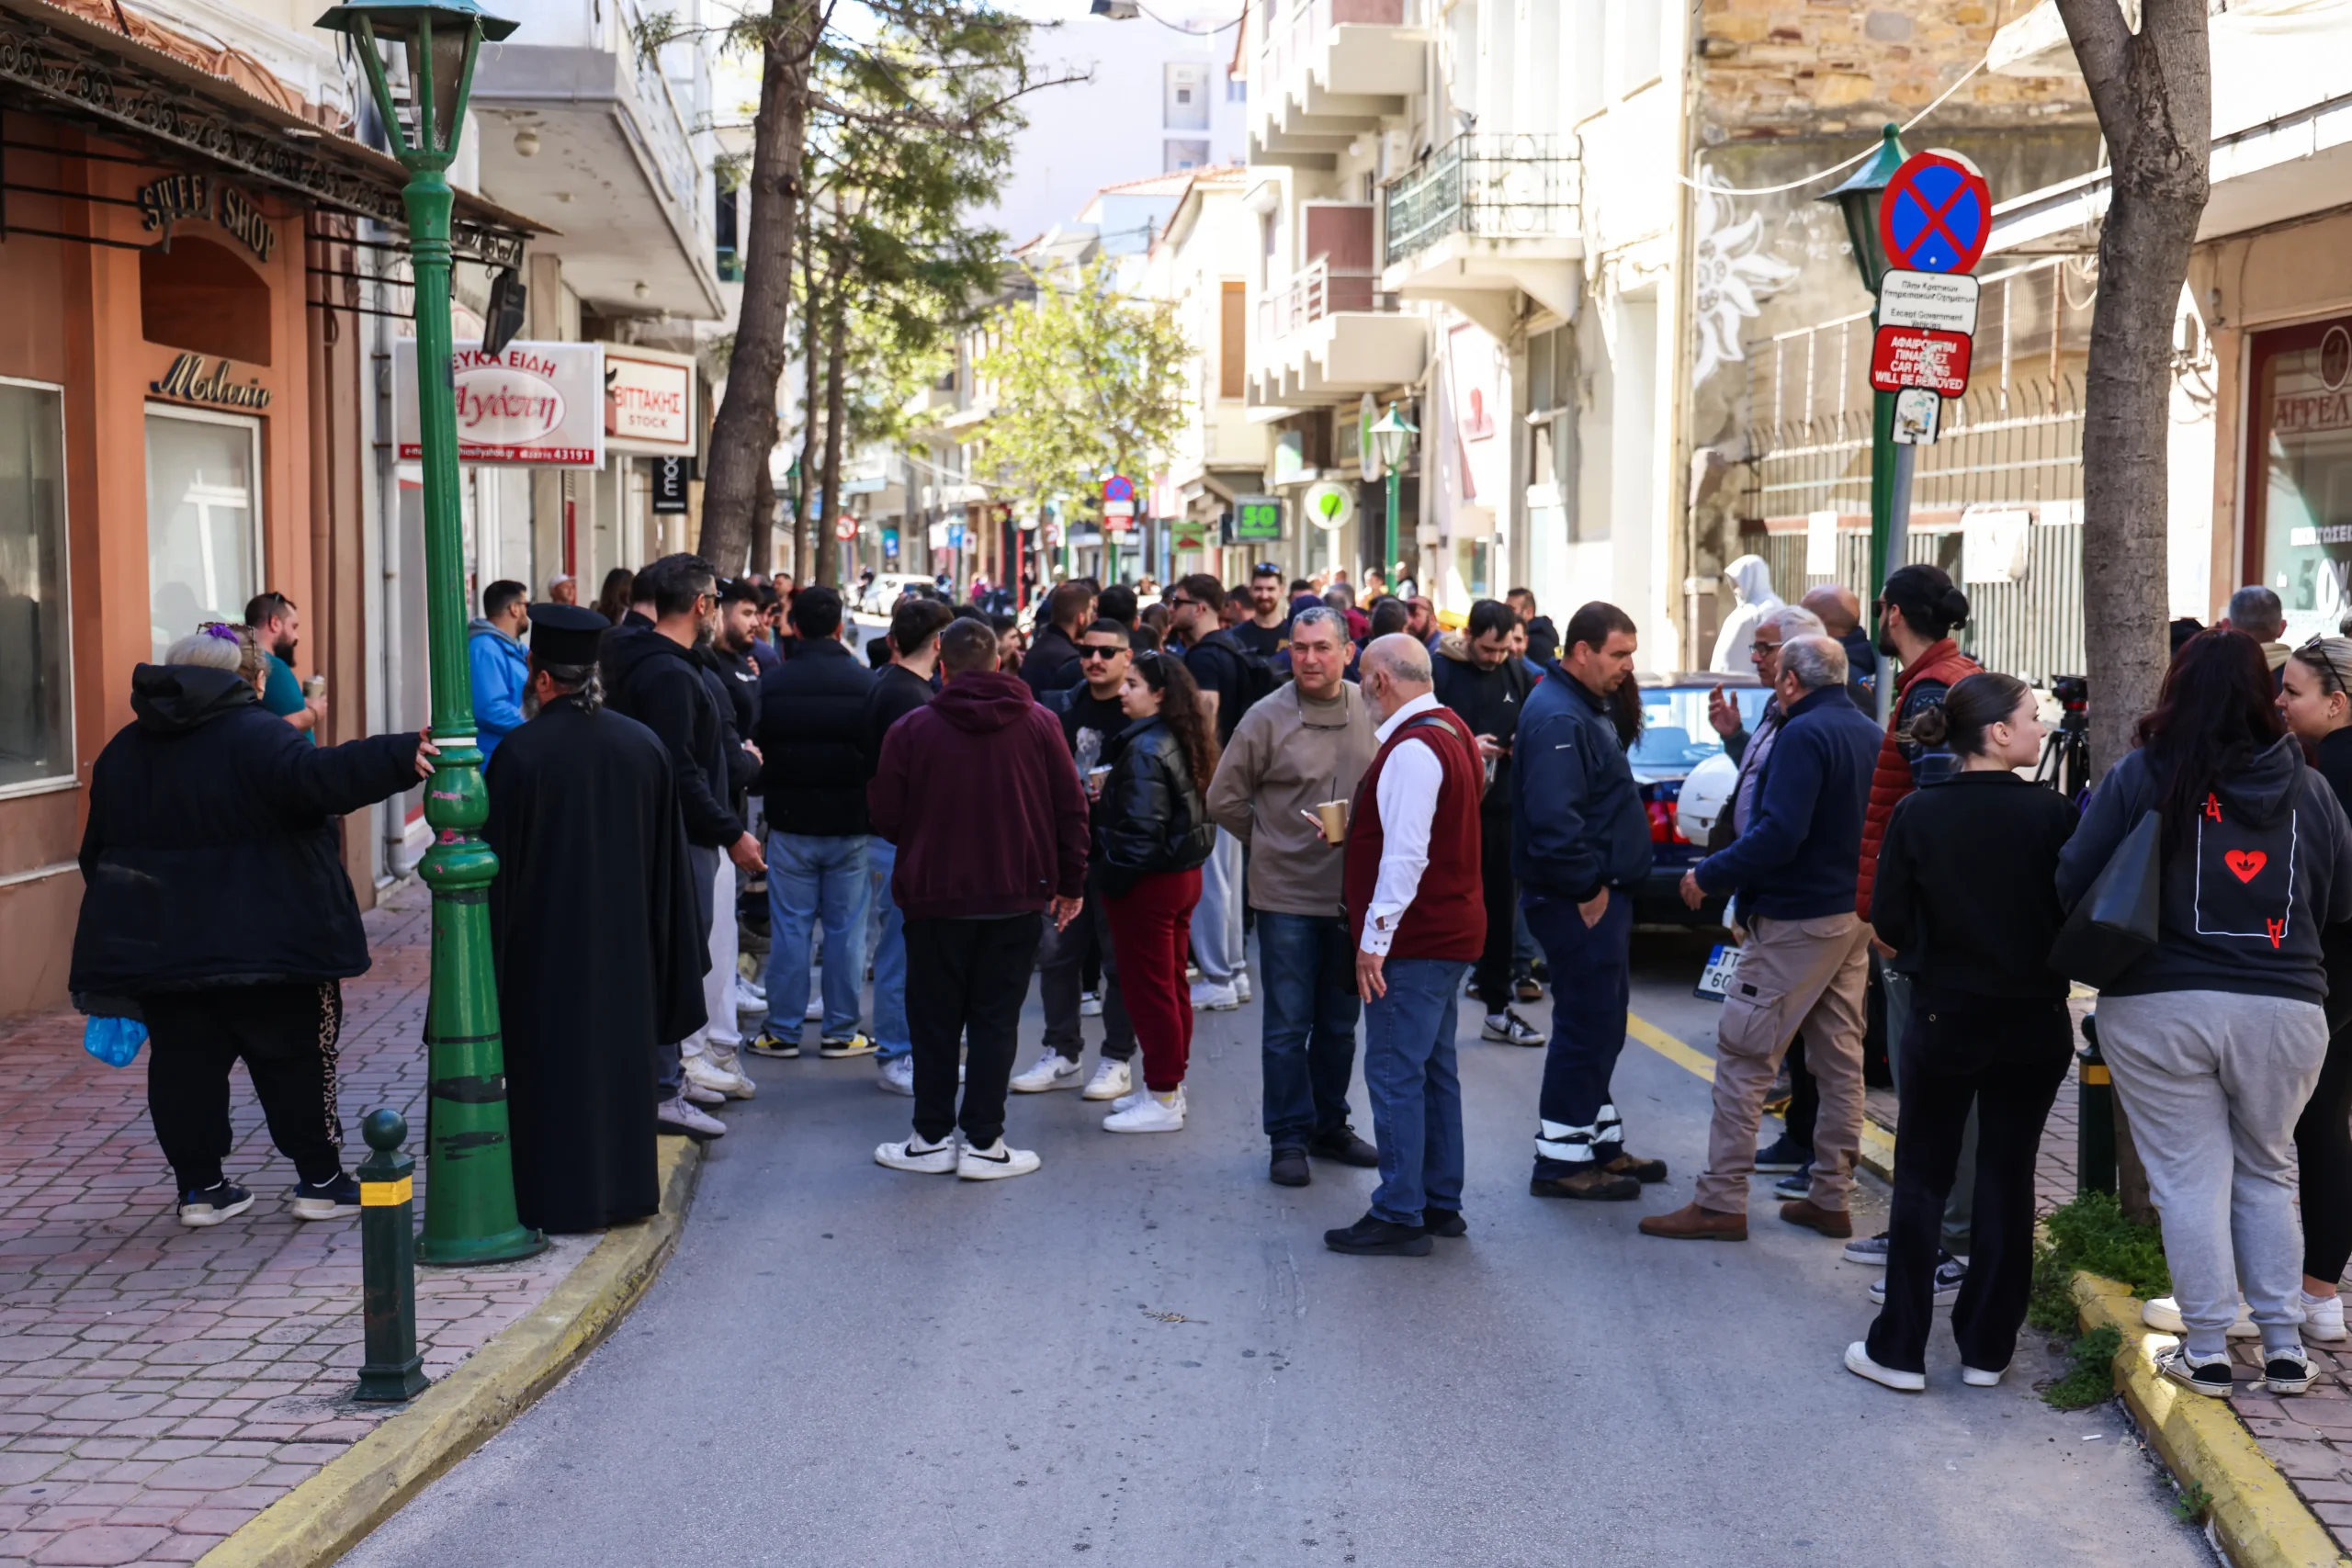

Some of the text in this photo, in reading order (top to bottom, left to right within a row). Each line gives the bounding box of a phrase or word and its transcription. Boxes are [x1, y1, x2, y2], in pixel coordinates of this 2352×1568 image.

[142, 174, 276, 263] SWEE SHOP
[1891, 309, 1963, 321] Except Government
[1911, 320, 1941, 330] Vehicles
[453, 350, 557, 378] ΕΥΚΑ ΕΙΔΗ
[1890, 360, 1913, 373] CAR
[1875, 370, 1964, 389] WILL BE REMOVED
[628, 415, 668, 429] STOCK
[553, 448, 591, 461] 43191
[2205, 792, 2222, 823] A
[2266, 918, 2284, 949] A
